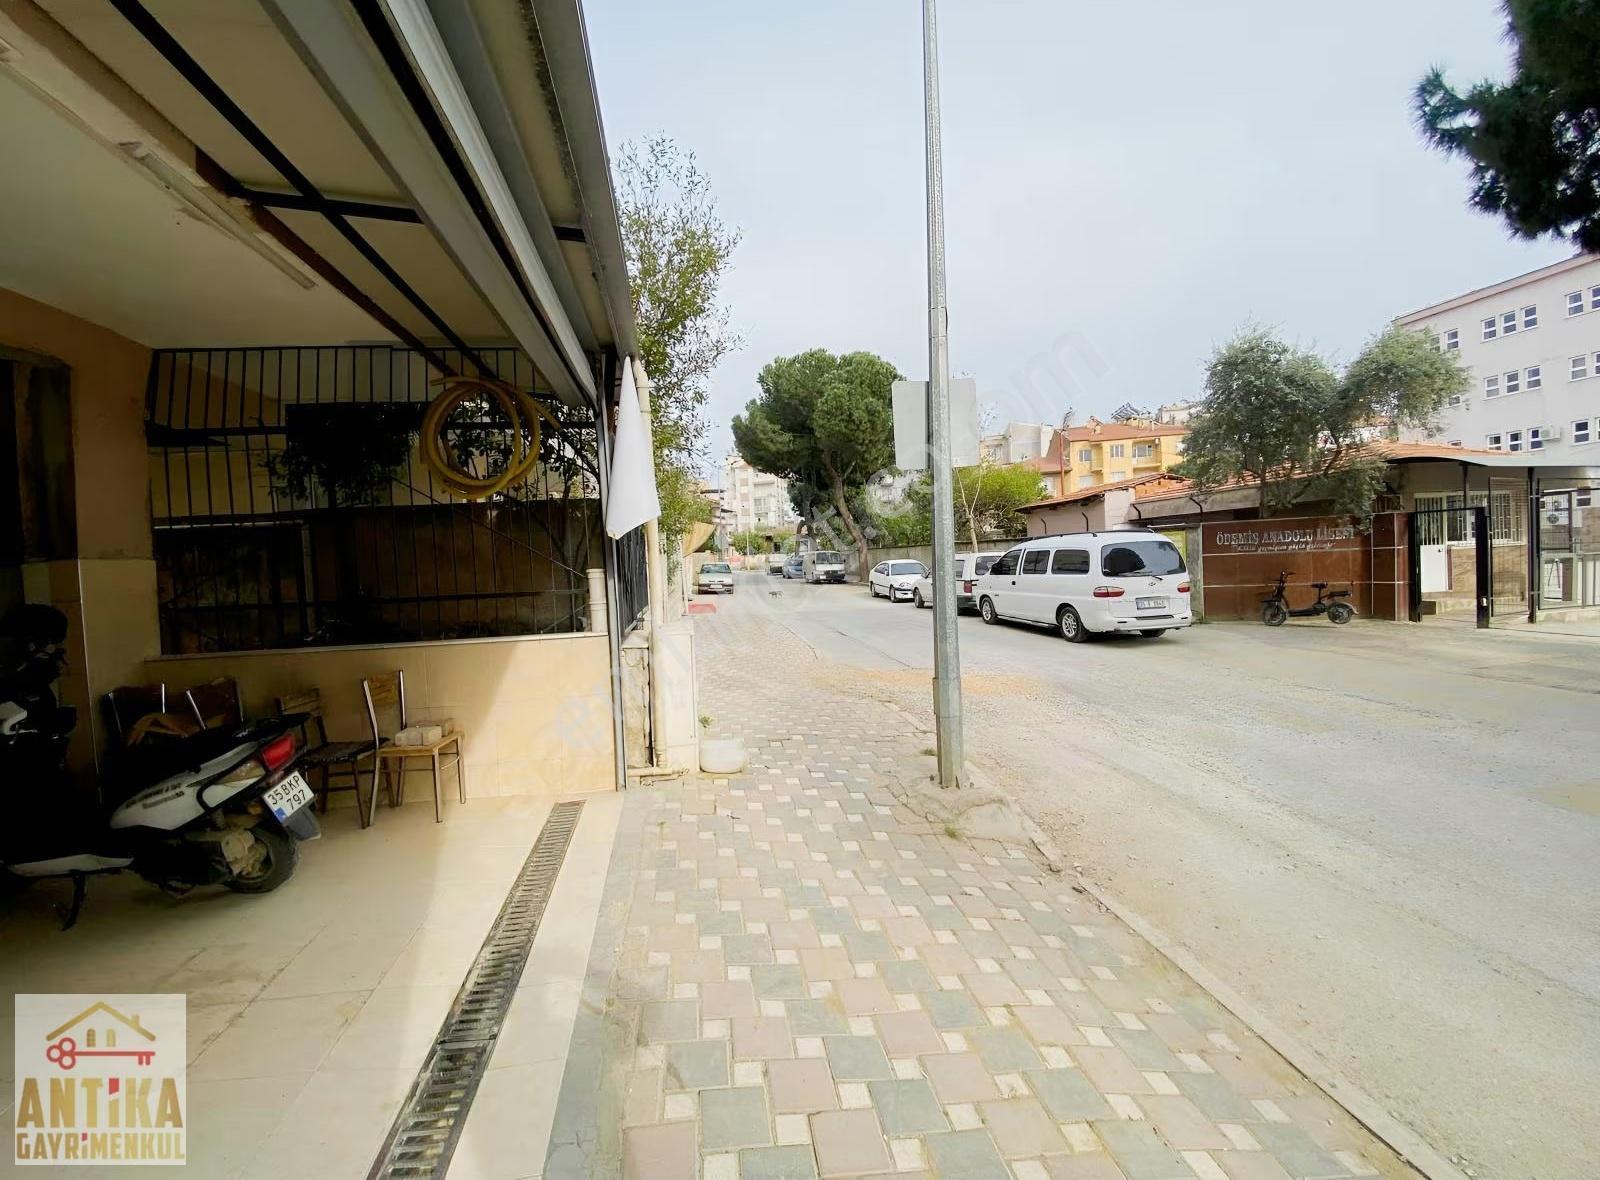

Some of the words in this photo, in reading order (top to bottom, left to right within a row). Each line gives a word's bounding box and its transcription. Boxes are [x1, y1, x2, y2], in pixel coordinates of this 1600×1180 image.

[1262, 529, 1313, 543] ANADOLU
[267, 775, 300, 805] 35BKP
[286, 789, 306, 810] 797
